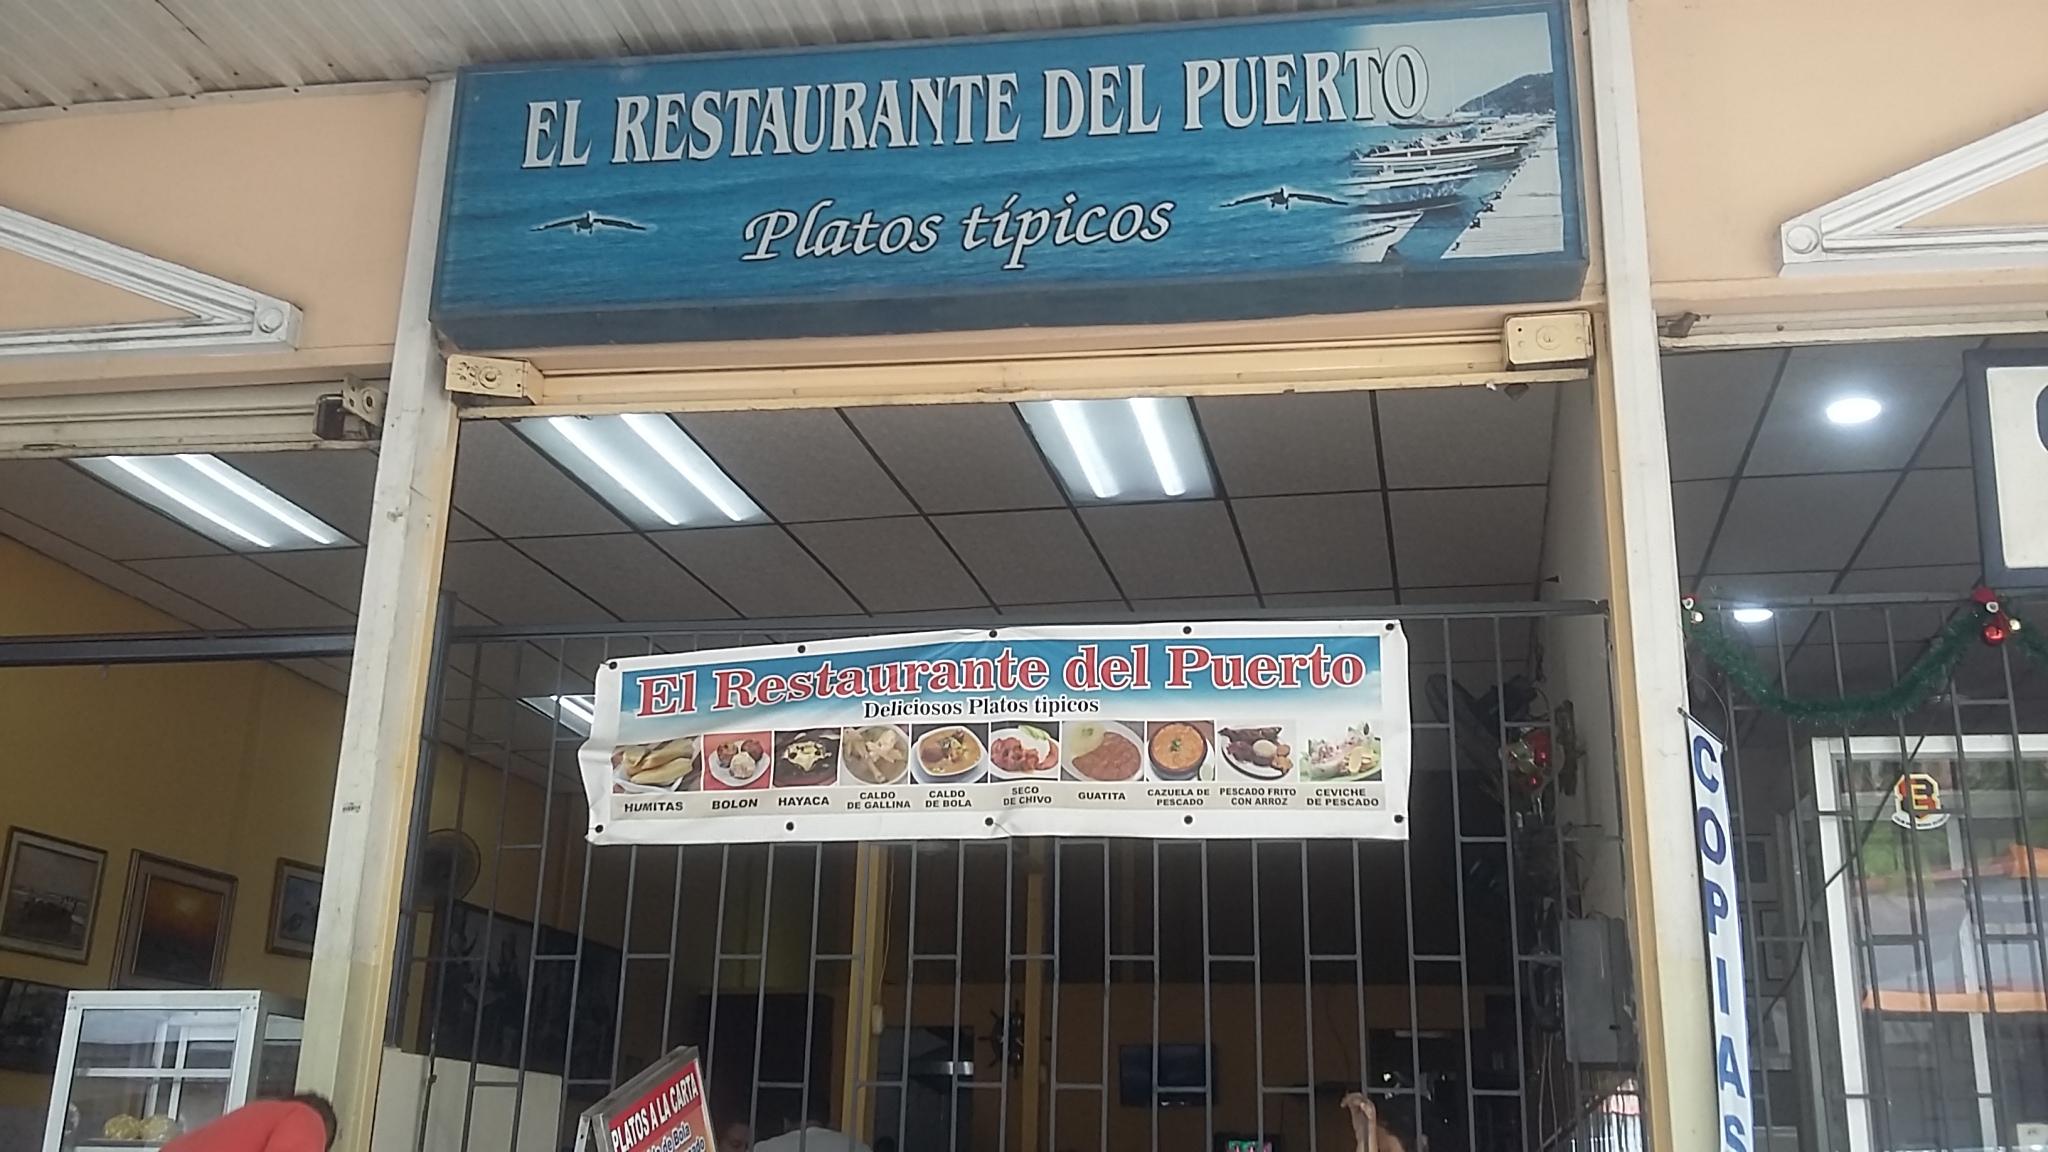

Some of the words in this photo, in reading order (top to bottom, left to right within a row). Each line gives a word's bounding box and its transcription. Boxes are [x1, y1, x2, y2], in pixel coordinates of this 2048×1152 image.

[521, 99, 593, 169] EL
[611, 72, 1022, 164] RESTAURANTE
[1043, 63, 1162, 140] DEL
[1182, 45, 1430, 132] PUERTO
[742, 199, 940, 261] Platos
[961, 193, 1175, 270] típicos
[636, 669, 698, 718] El
[710, 646, 1050, 712] Restaurante
[1063, 643, 1151, 691] del
[1165, 643, 1366, 690] Puerto
[864, 699, 963, 718] Deliciosos
[968, 696, 1029, 715] Platos
[1034, 696, 1100, 717] tipicos
[859, 791, 896, 800] CALDO
[929, 790, 966, 798] CALDO
[1011, 786, 1040, 796] SECO
[1078, 791, 1126, 801] GUATITA
[1147, 788, 1194, 798] CAZUELA
[1197, 788, 1210, 798] DE
[1219, 787, 1265, 797] PESCADO
[1268, 787, 1297, 797] FRITO
[1315, 787, 1366, 797] CEVICHE
[711, 798, 758, 810] BOLON
[778, 795, 830, 807] HAYACA
[846, 800, 862, 810] DE
[864, 799, 911, 809] GALLINA
[925, 799, 941, 808] DE
[943, 798, 972, 808] BOLA
[1003, 796, 1017, 805] DE
[1019, 795, 1052, 805] CHIVO
[1156, 798, 1204, 807] PESCADO
[1231, 797, 1253, 807] CON
[1255, 796, 1288, 807] ARROZ
[1306, 797, 1324, 807] DE
[1326, 797, 1380, 807] PESCADO
[624, 800, 684, 812] HUMITAS
[1692, 735, 1747, 1152] COPIAS
[611, 1107, 651, 1152] PLATOS
[650, 1102, 660, 1131] A
[656, 1092, 673, 1124] LA
[669, 1073, 699, 1114] CARTA
[672, 1122, 691, 1149] Bola
